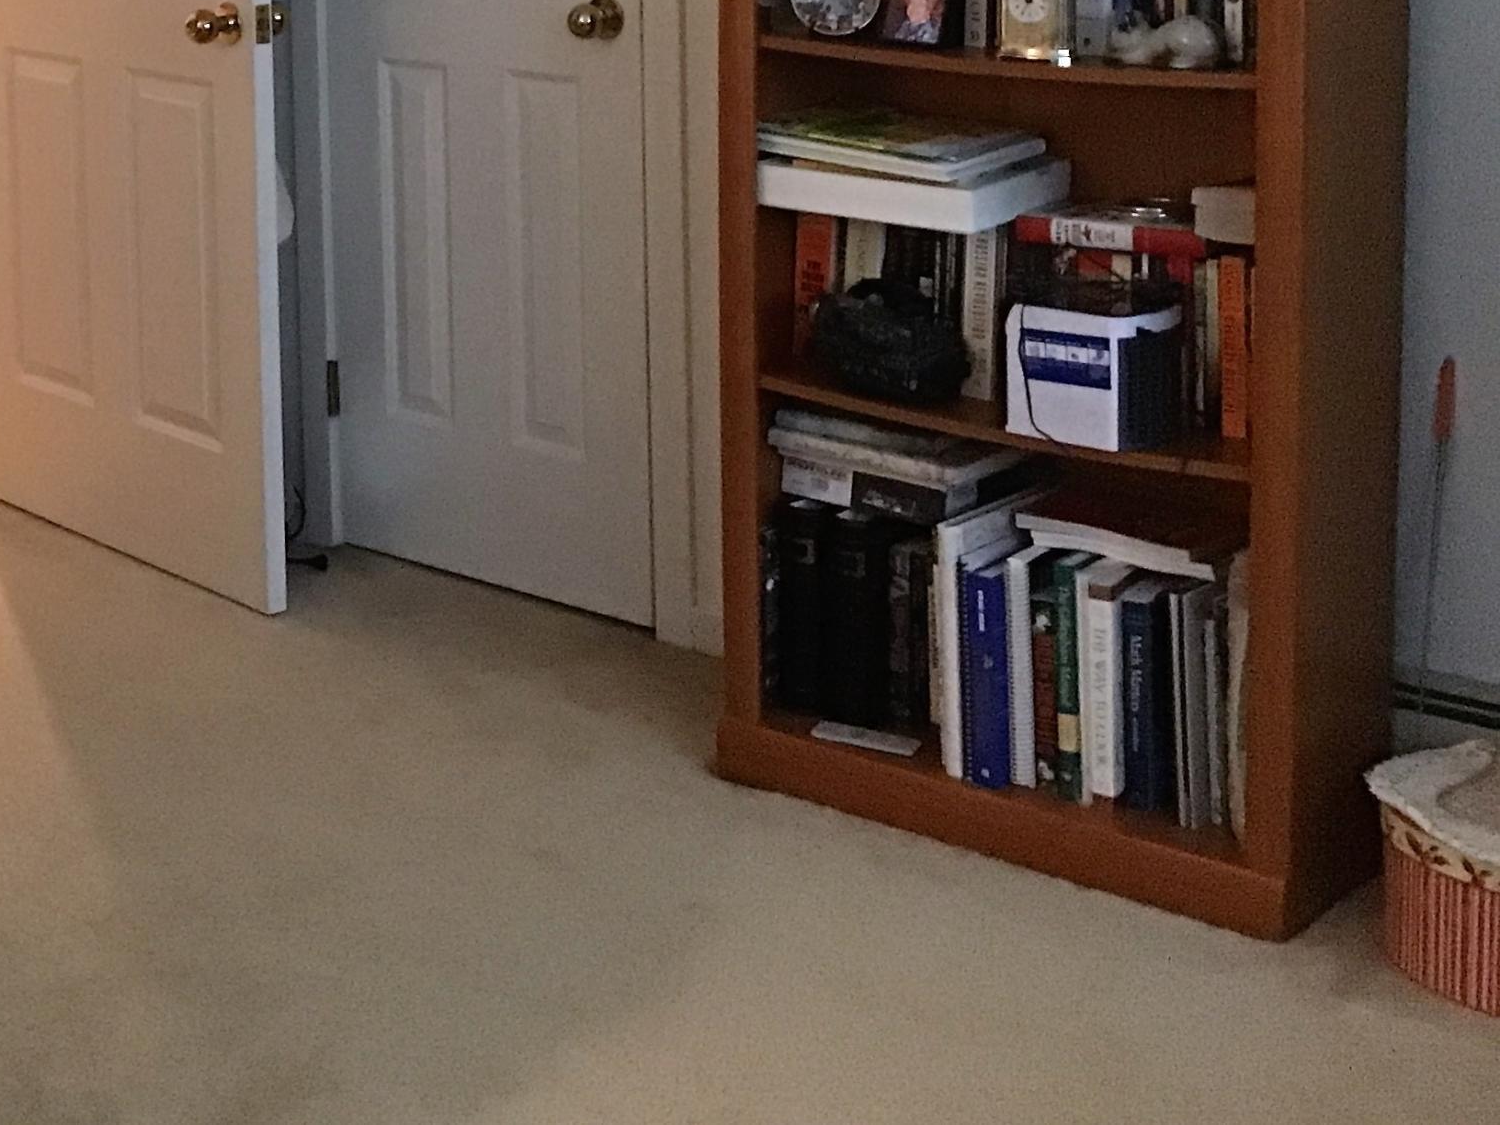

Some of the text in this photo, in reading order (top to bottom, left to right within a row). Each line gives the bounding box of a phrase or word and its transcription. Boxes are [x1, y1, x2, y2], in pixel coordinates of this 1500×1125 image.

[973, 238, 988, 278] RUSSIAN
[972, 281, 987, 339] REVOLUTION
[1093, 660, 1106, 692] WAY
